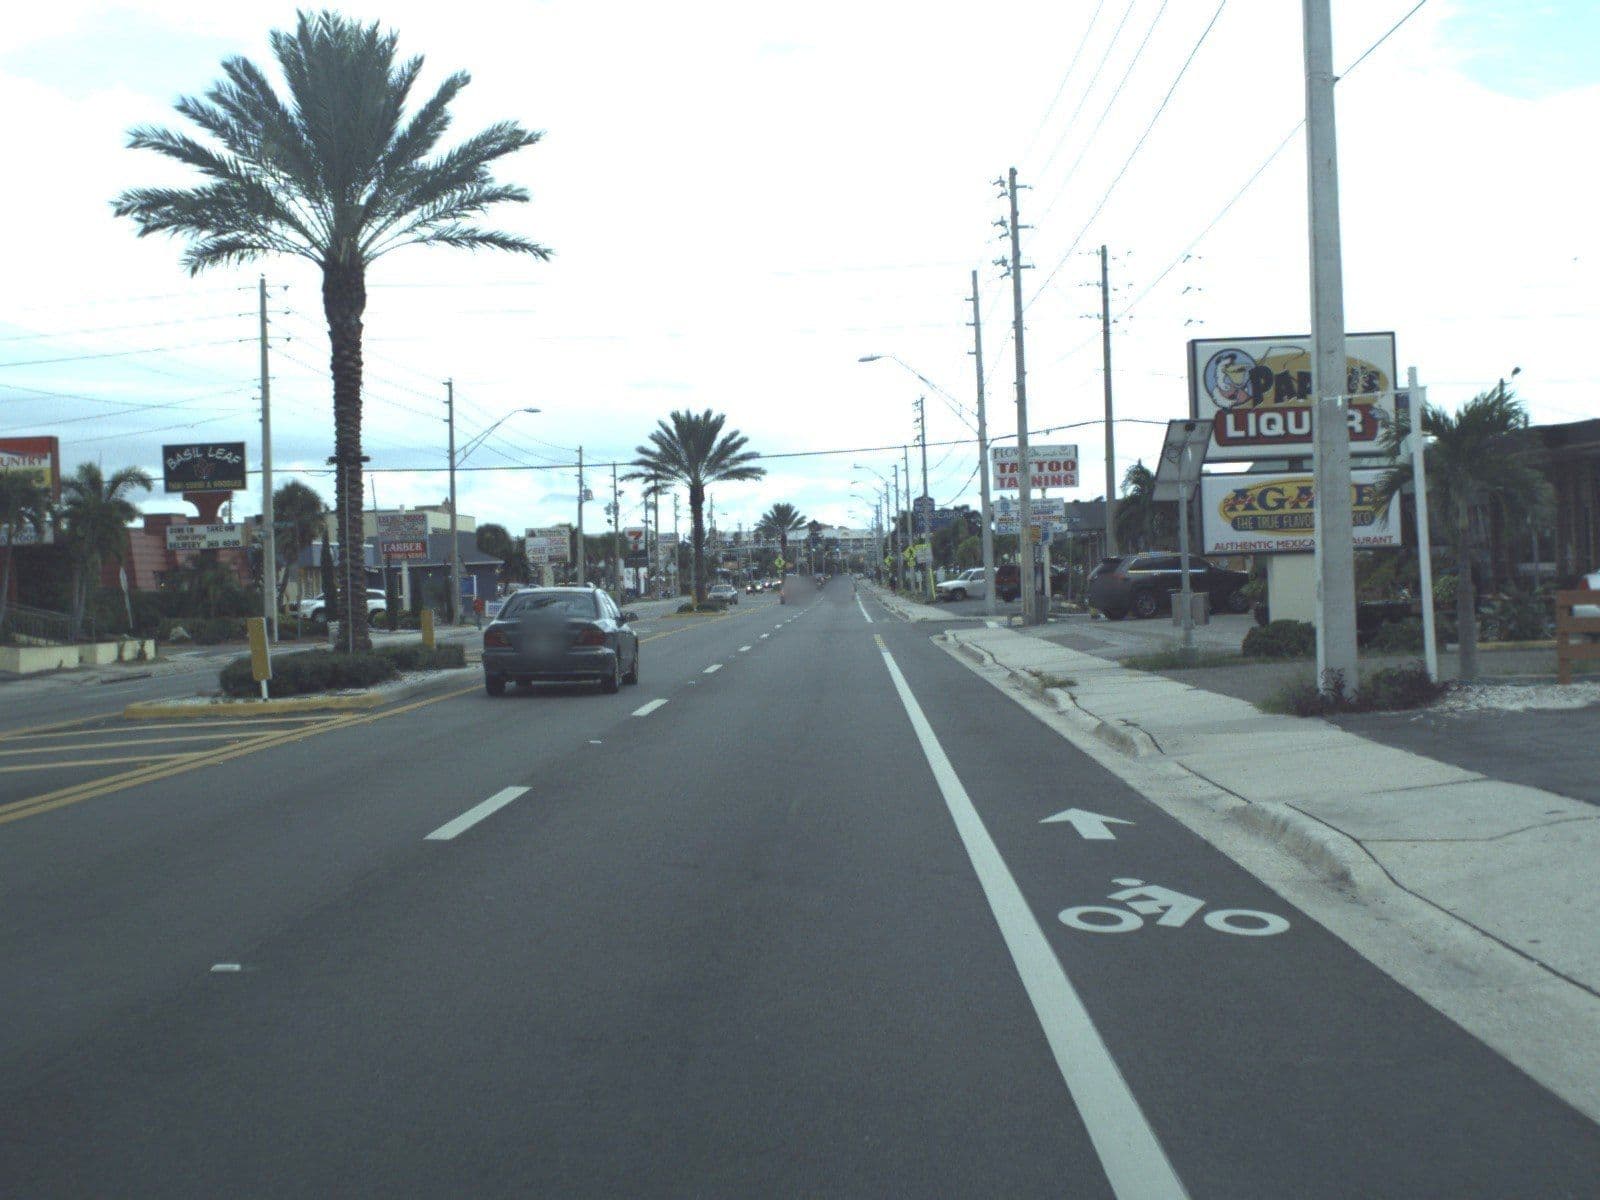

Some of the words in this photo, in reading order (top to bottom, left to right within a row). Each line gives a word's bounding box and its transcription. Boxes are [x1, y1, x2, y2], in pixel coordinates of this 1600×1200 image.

[1225, 410, 1364, 439] LIQUR
[167, 447, 203, 470] BASIL
[208, 446, 242, 464] LEAF
[997, 460, 1077, 474] TATOO
[998, 474, 1076, 488] TANING
[1226, 484, 1376, 512] AGAE
[1237, 515, 1254, 529] THE
[1284, 513, 1315, 528] FLAVO
[1214, 540, 1273, 552] AUTHENTIC
[1276, 538, 1315, 550] MEXICA
